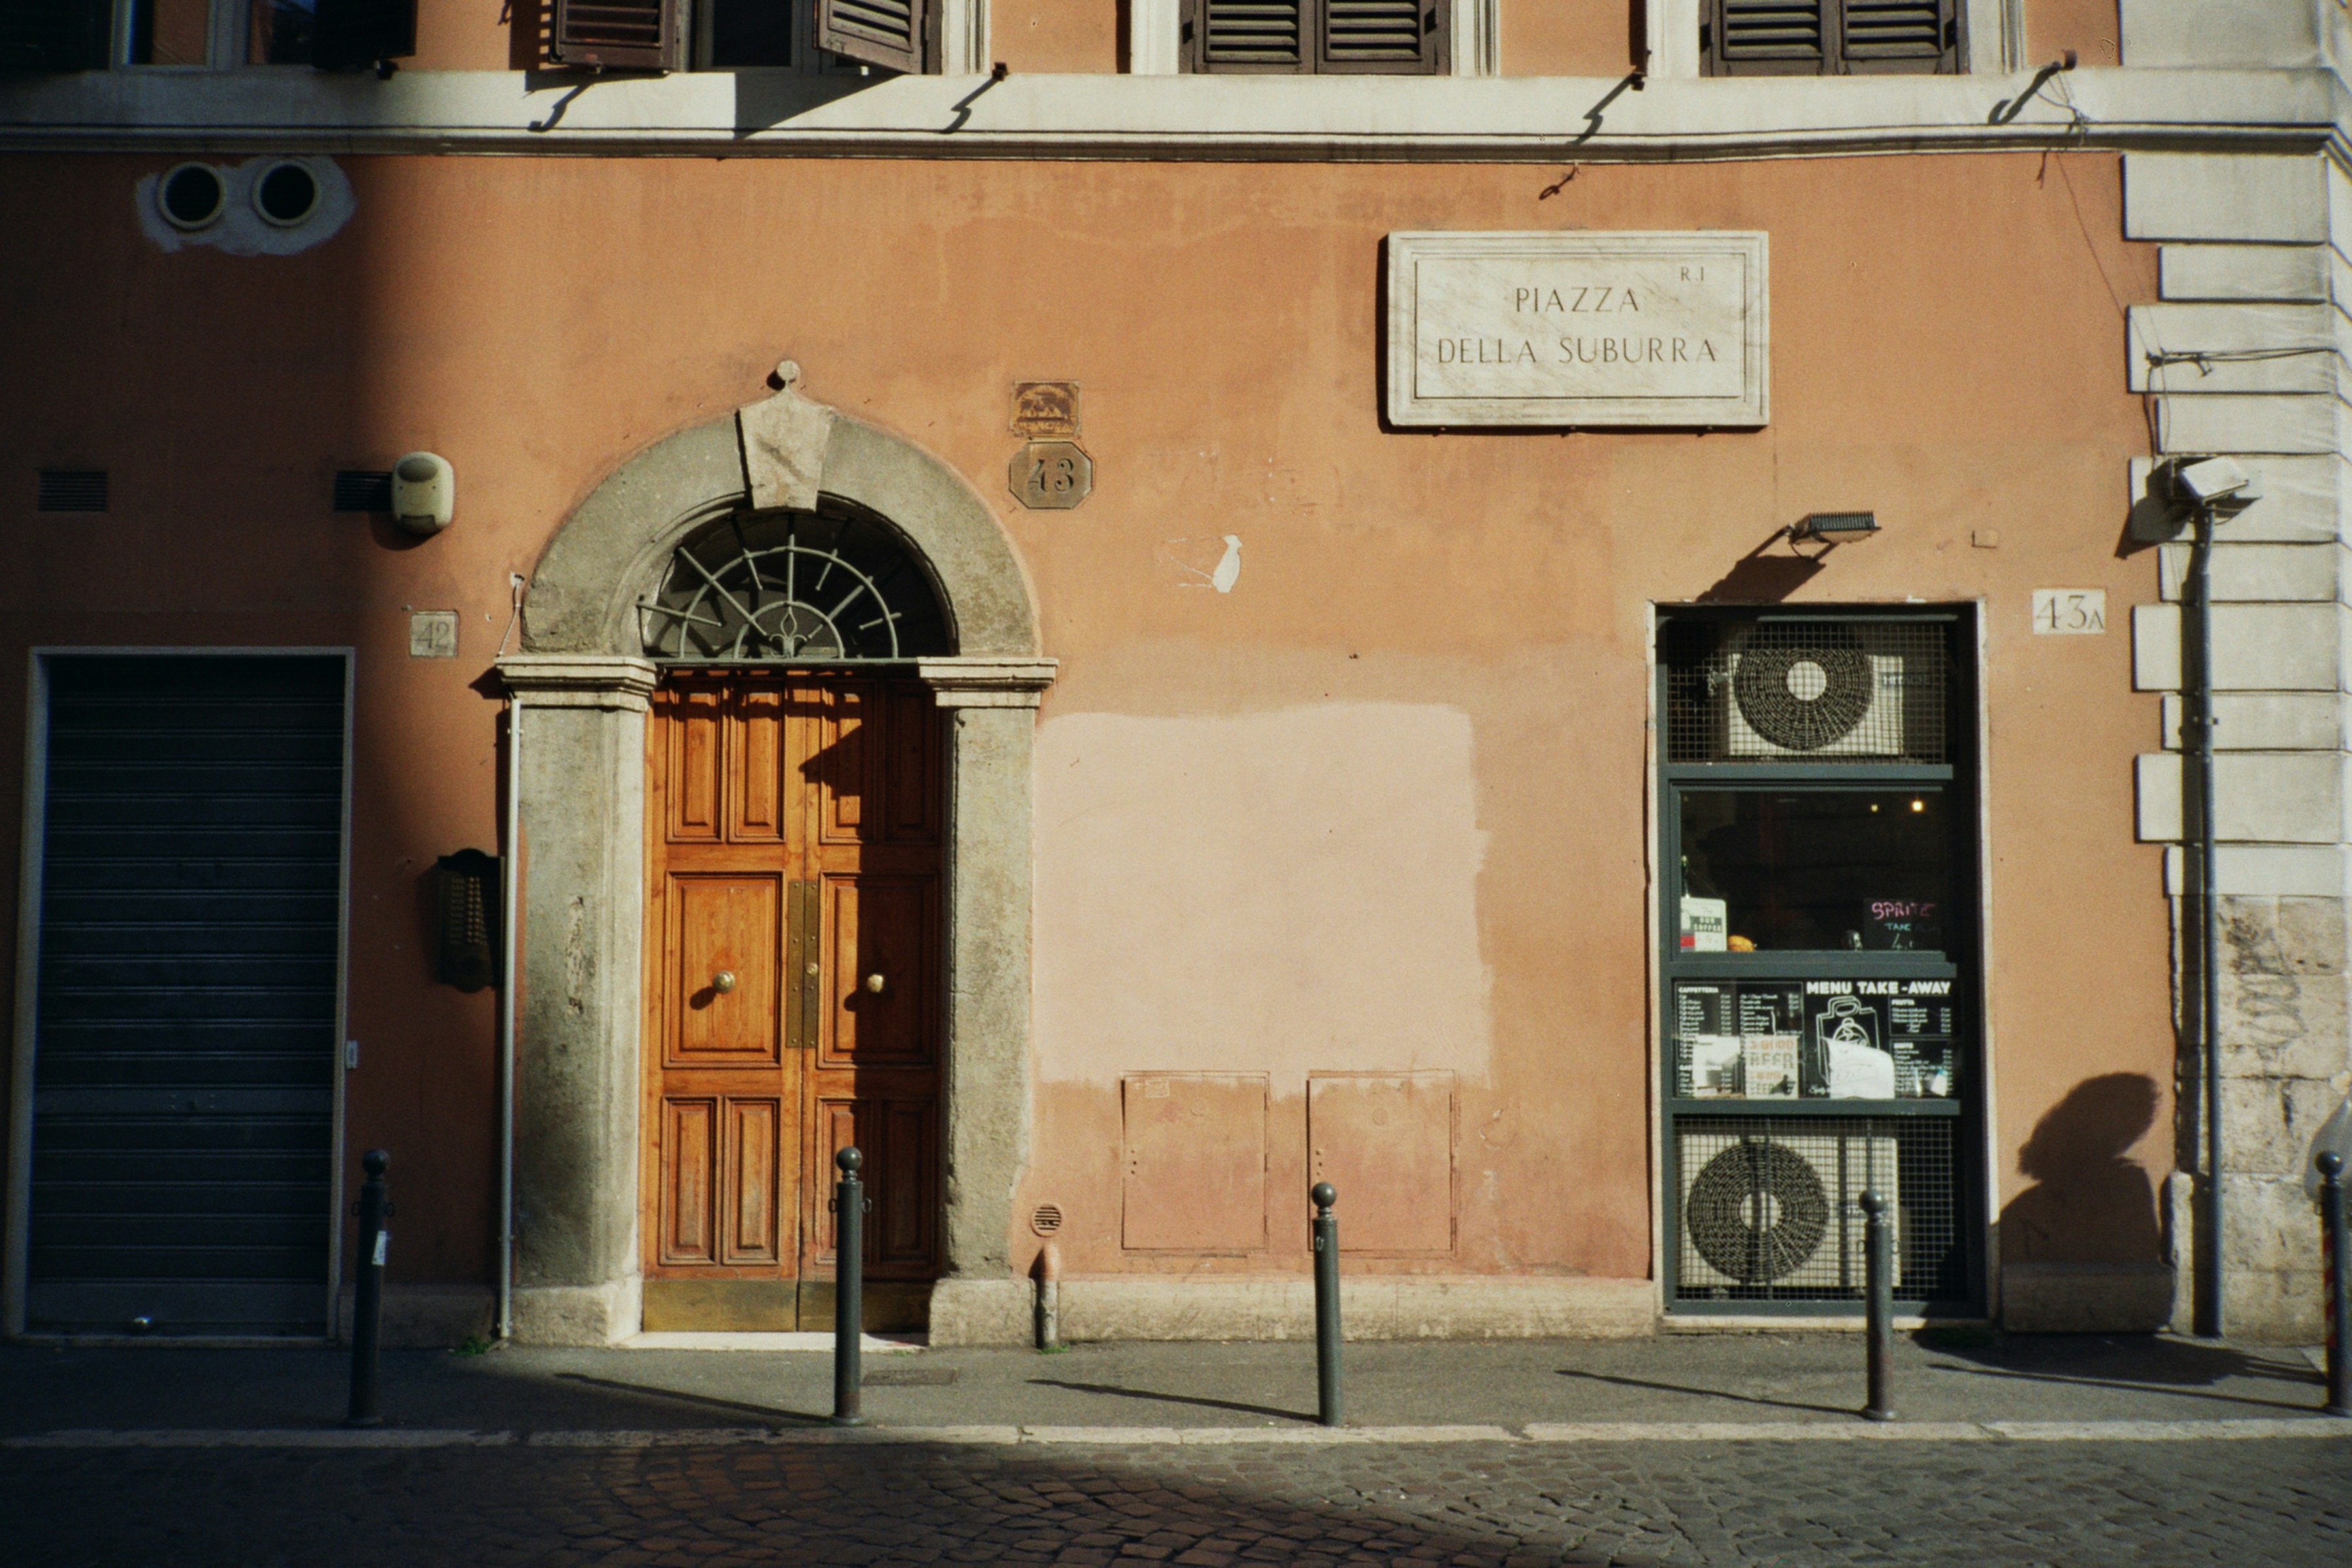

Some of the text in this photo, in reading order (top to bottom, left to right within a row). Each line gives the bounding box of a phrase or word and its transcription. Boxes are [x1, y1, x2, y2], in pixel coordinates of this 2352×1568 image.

[1516, 287, 1640, 312] PIAZZA
[1438, 337, 1716, 364] DELLA SUBURRA
[1027, 459, 1074, 492] 43
[414, 621, 449, 649] 42
[1806, 981, 1852, 994] MENU
